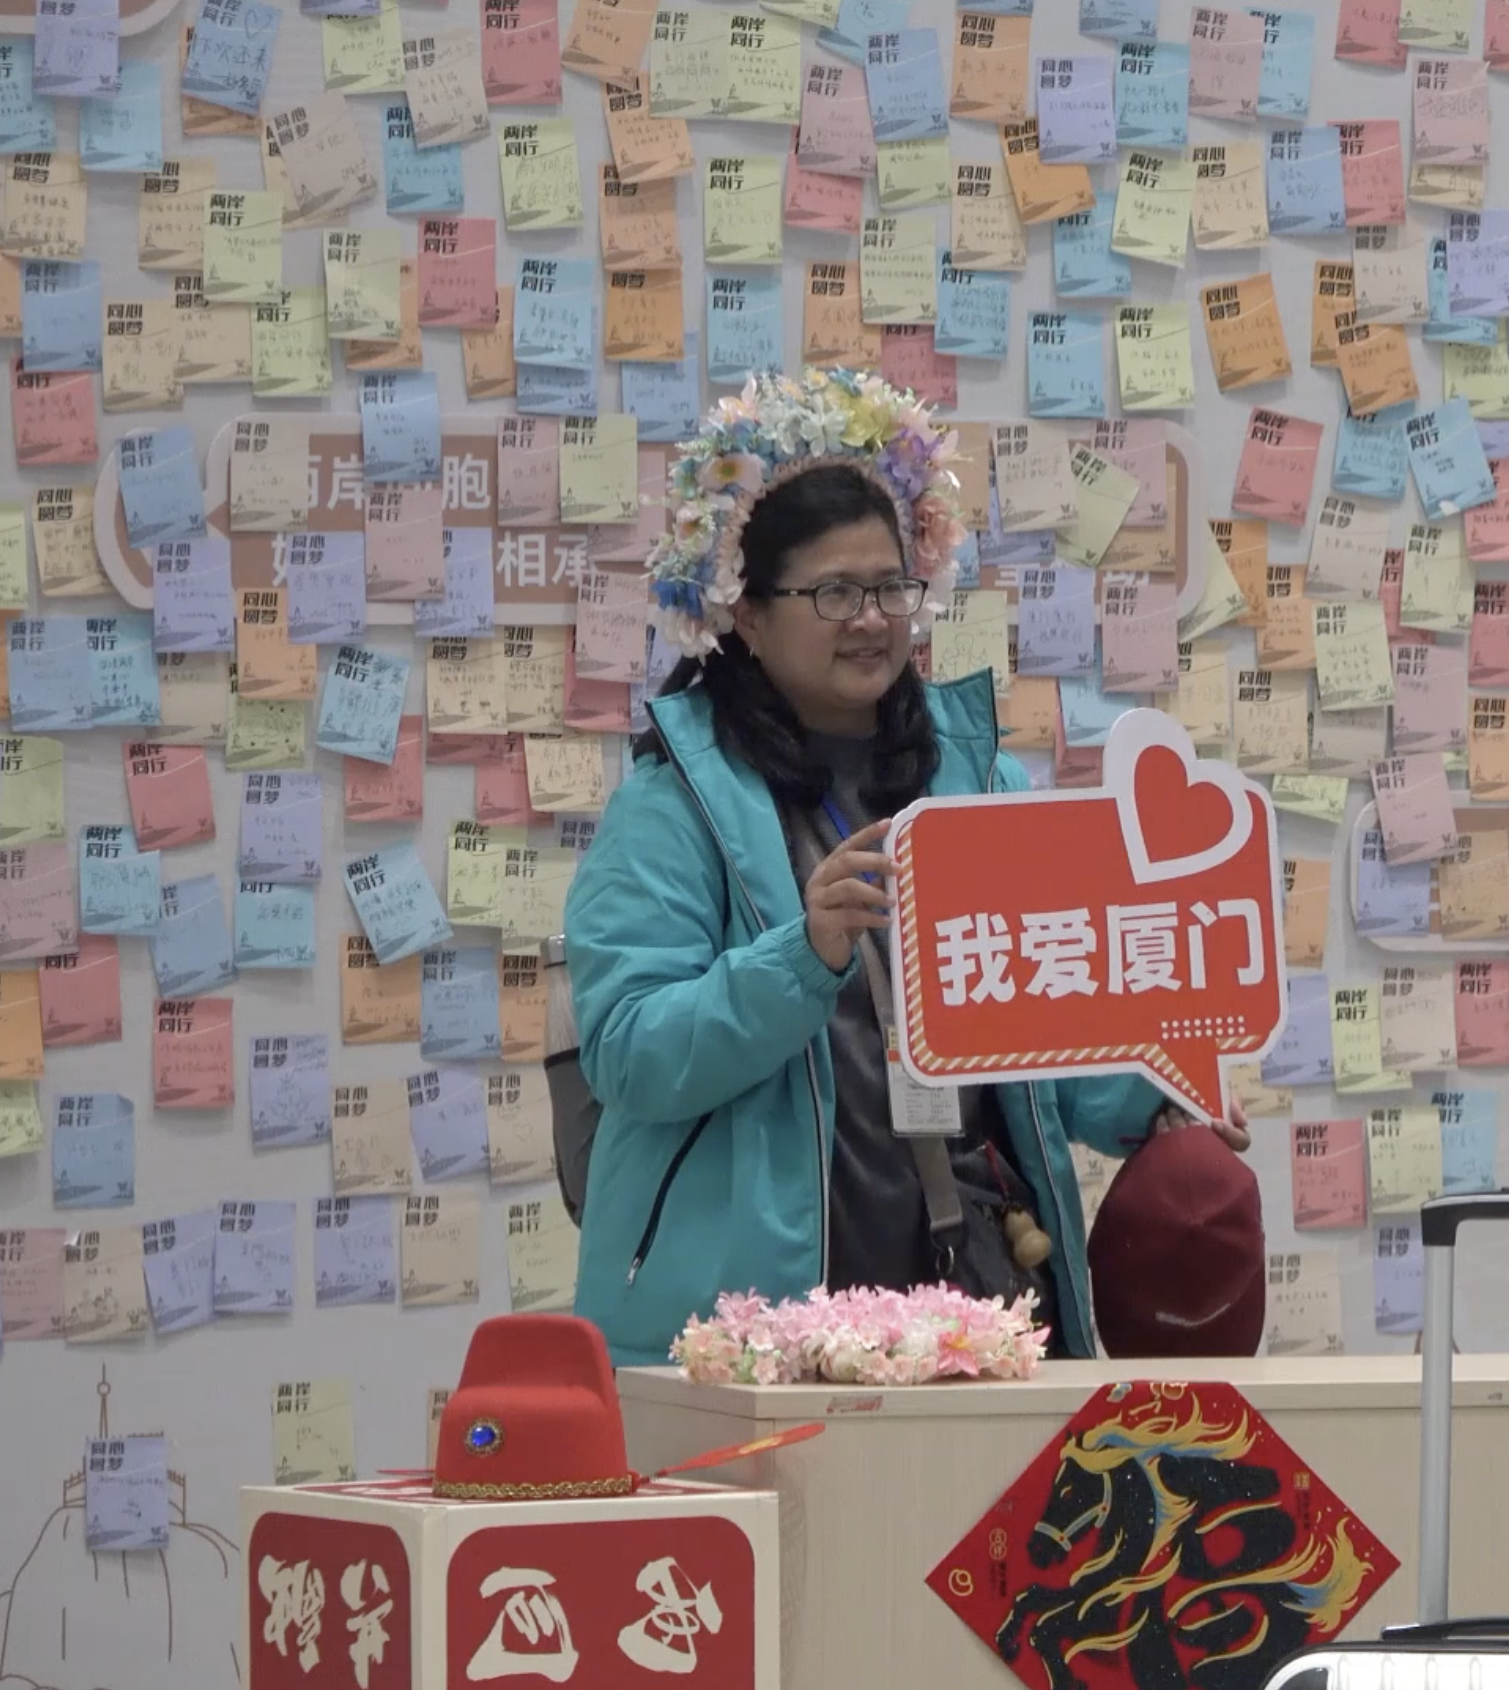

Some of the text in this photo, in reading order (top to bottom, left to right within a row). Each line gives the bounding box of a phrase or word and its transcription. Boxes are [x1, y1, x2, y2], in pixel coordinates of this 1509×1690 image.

[656, 11, 689, 26] 两岸
[730, 15, 765, 32] 两岸
[960, 13, 996, 32] 同心
[653, 26, 686, 42] 同行
[730, 32, 764, 49] 同行
[868, 33, 900, 49] 两岸
[959, 31, 994, 49] 圆梦
[401, 37, 435, 55] 同心
[403, 52, 436, 72] 圆梦
[867, 48, 899, 65] 同行
[809, 64, 843, 82] 两岸
[1041, 58, 1074, 74] 同心
[1417, 60, 1449, 75] 两岸
[806, 80, 839, 97] 同行
[1040, 74, 1072, 89] 圆梦
[1416, 75, 1446, 90] 同行
[274, 106, 307, 129] 同心
[277, 121, 310, 147] 圆梦
[503, 124, 538, 140] 两岸
[1270, 129, 1303, 145] 两岸
[504, 140, 538, 157] 同行
[1192, 146, 1226, 162] 同心
[1269, 145, 1300, 161] 同行
[709, 158, 744, 174] 两岸
[957, 165, 992, 181] 同心
[1196, 162, 1226, 179] 圆梦
[709, 174, 743, 191] 同行
[957, 181, 991, 197] 圆梦
[209, 193, 245, 210] 两岸
[209, 211, 243, 227] 同行
[1449, 212, 1481, 228] 同心
[423, 219, 459, 237] 两岸
[1448, 226, 1480, 243] 圆梦
[328, 232, 362, 248] 两岸
[423, 237, 458, 254] 同行
[327, 247, 358, 263] 同行
[521, 258, 557, 276] 两岸
[810, 263, 846, 280] 同心
[520, 275, 555, 293] 同行
[712, 278, 746, 294] 两岸
[810, 280, 845, 297] 圆梦
[712, 294, 745, 311] 同行
[1205, 284, 1238, 305] 同心
[106, 303, 143, 319] 同心
[1119, 307, 1154, 323] 两岸
[1208, 300, 1241, 322] 圆梦
[107, 320, 143, 336] 圆梦
[1032, 312, 1066, 329] 两岸
[1033, 329, 1065, 345] 同行
[1120, 323, 1152, 339] 同行
[363, 374, 397, 389] 两岸
[363, 390, 394, 405] 同行
[1253, 409, 1290, 429] 两岸
[1406, 412, 1436, 435] 两岸
[996, 424, 1029, 441] 同心
[1250, 425, 1283, 446] 同行
[1409, 427, 1439, 451] 同行
[996, 439, 1028, 457] 圆梦
[36, 488, 73, 504] 同心
[369, 491, 403, 507] 两岸
[37, 504, 74, 522] 圆梦
[368, 507, 400, 523] 同行
[158, 542, 191, 558] 同心
[291, 535, 326, 550] 同心
[156, 558, 190, 574] 圆梦
[289, 550, 324, 566] 圆梦
[1023, 569, 1057, 584] 同心
[1021, 584, 1055, 600] 圆梦
[1473, 582, 1506, 599] 两岸
[242, 592, 279, 608] 同心
[1472, 598, 1505, 617] 同行
[242, 608, 278, 625] 圆梦
[1316, 605, 1347, 620] 两岸
[11, 619, 46, 636] 两岸
[1316, 620, 1345, 636] 同行
[10, 636, 45, 652] 同行
[337, 645, 374, 666] 两岸
[334, 661, 369, 683] 同行
[1238, 668, 1272, 686] 同心
[1238, 686, 1272, 702] 圆梦
[1473, 697, 1506, 713] 同心
[1473, 714, 1506, 730] 圆梦
[247, 773, 282, 789] 同心
[245, 789, 280, 805] 圆梦
[85, 825, 123, 841] 两岸
[86, 842, 122, 859] 同行
[346, 854, 379, 879] 两岸
[352, 869, 385, 896] 同行
[933, 897, 1266, 1006] 我爱厦门
[1459, 962, 1492, 978] 两岸
[1459, 979, 1491, 995] 同行
[157, 1000, 195, 1017] 两岸
[158, 1017, 192, 1034] 同行
[254, 1036, 288, 1053] 同心
[252, 1052, 288, 1069] 圆梦
[334, 1086, 368, 1102] 同心
[333, 1102, 367, 1118] 圆梦
[1295, 1124, 1328, 1141] 两岸
[1295, 1140, 1328, 1158] 同行
[221, 1201, 256, 1217] 同心
[405, 1196, 440, 1211] 同心
[219, 1217, 254, 1233] 圆梦
[404, 1211, 439, 1227] 圆梦
